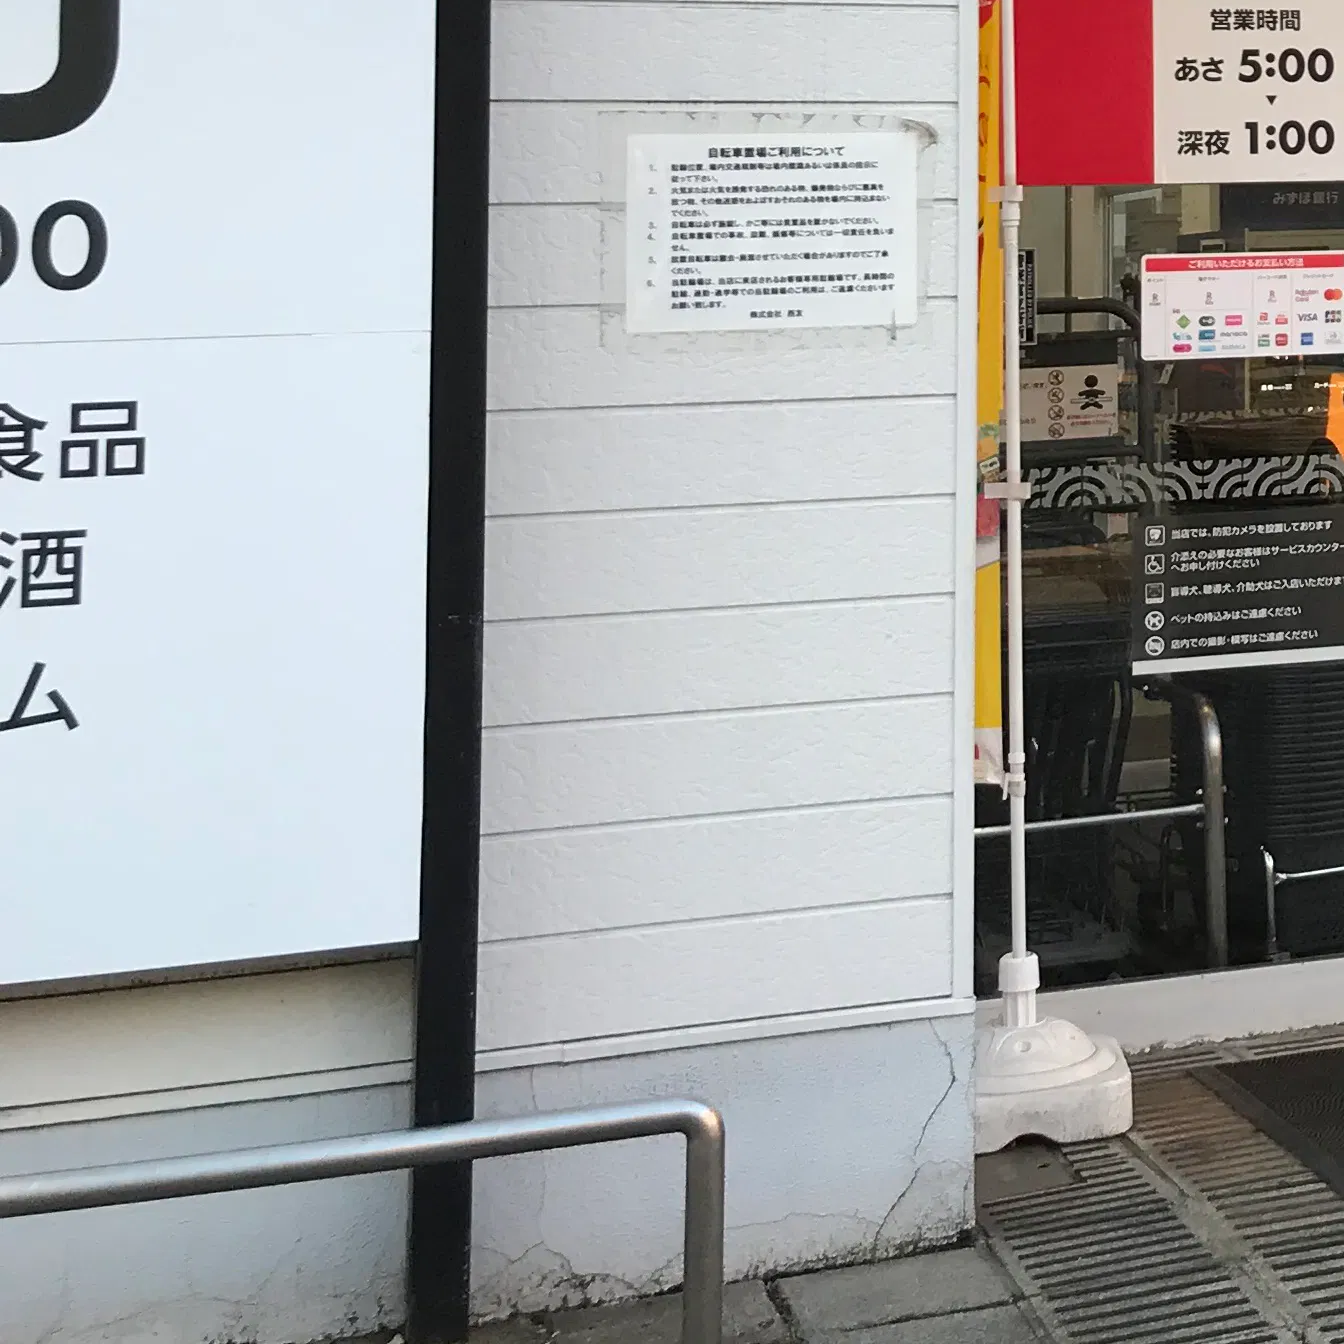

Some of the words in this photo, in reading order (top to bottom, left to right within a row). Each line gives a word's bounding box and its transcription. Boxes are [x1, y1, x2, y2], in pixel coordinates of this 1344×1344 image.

[1209, 9, 1301, 32] 営業時間
[1174, 56, 1224, 82] あさ
[1238, 48, 1334, 83] 5:00
[1177, 130, 1230, 156] 深夜
[1244, 120, 1335, 155] 1:00
[707, 146, 845, 158] 自転車置場ご利用について
[1189, 258, 1304, 269] ご利用いただけるお支払い方法
[1297, 313, 1318, 322] VISA
[0, 400, 146, 482] 食品
[1171, 520, 1333, 540] 当店では、防犯カメラを設置しております
[0, 529, 88, 608] 酒
[1171, 558, 1260, 572] へお申し付けください
[1171, 606, 1302, 624] ペットの持込みはご遠慮ください
[1171, 629, 1319, 650] 店内での撮影・模写はご遠慮ください
[0, 661, 80, 732] ム
